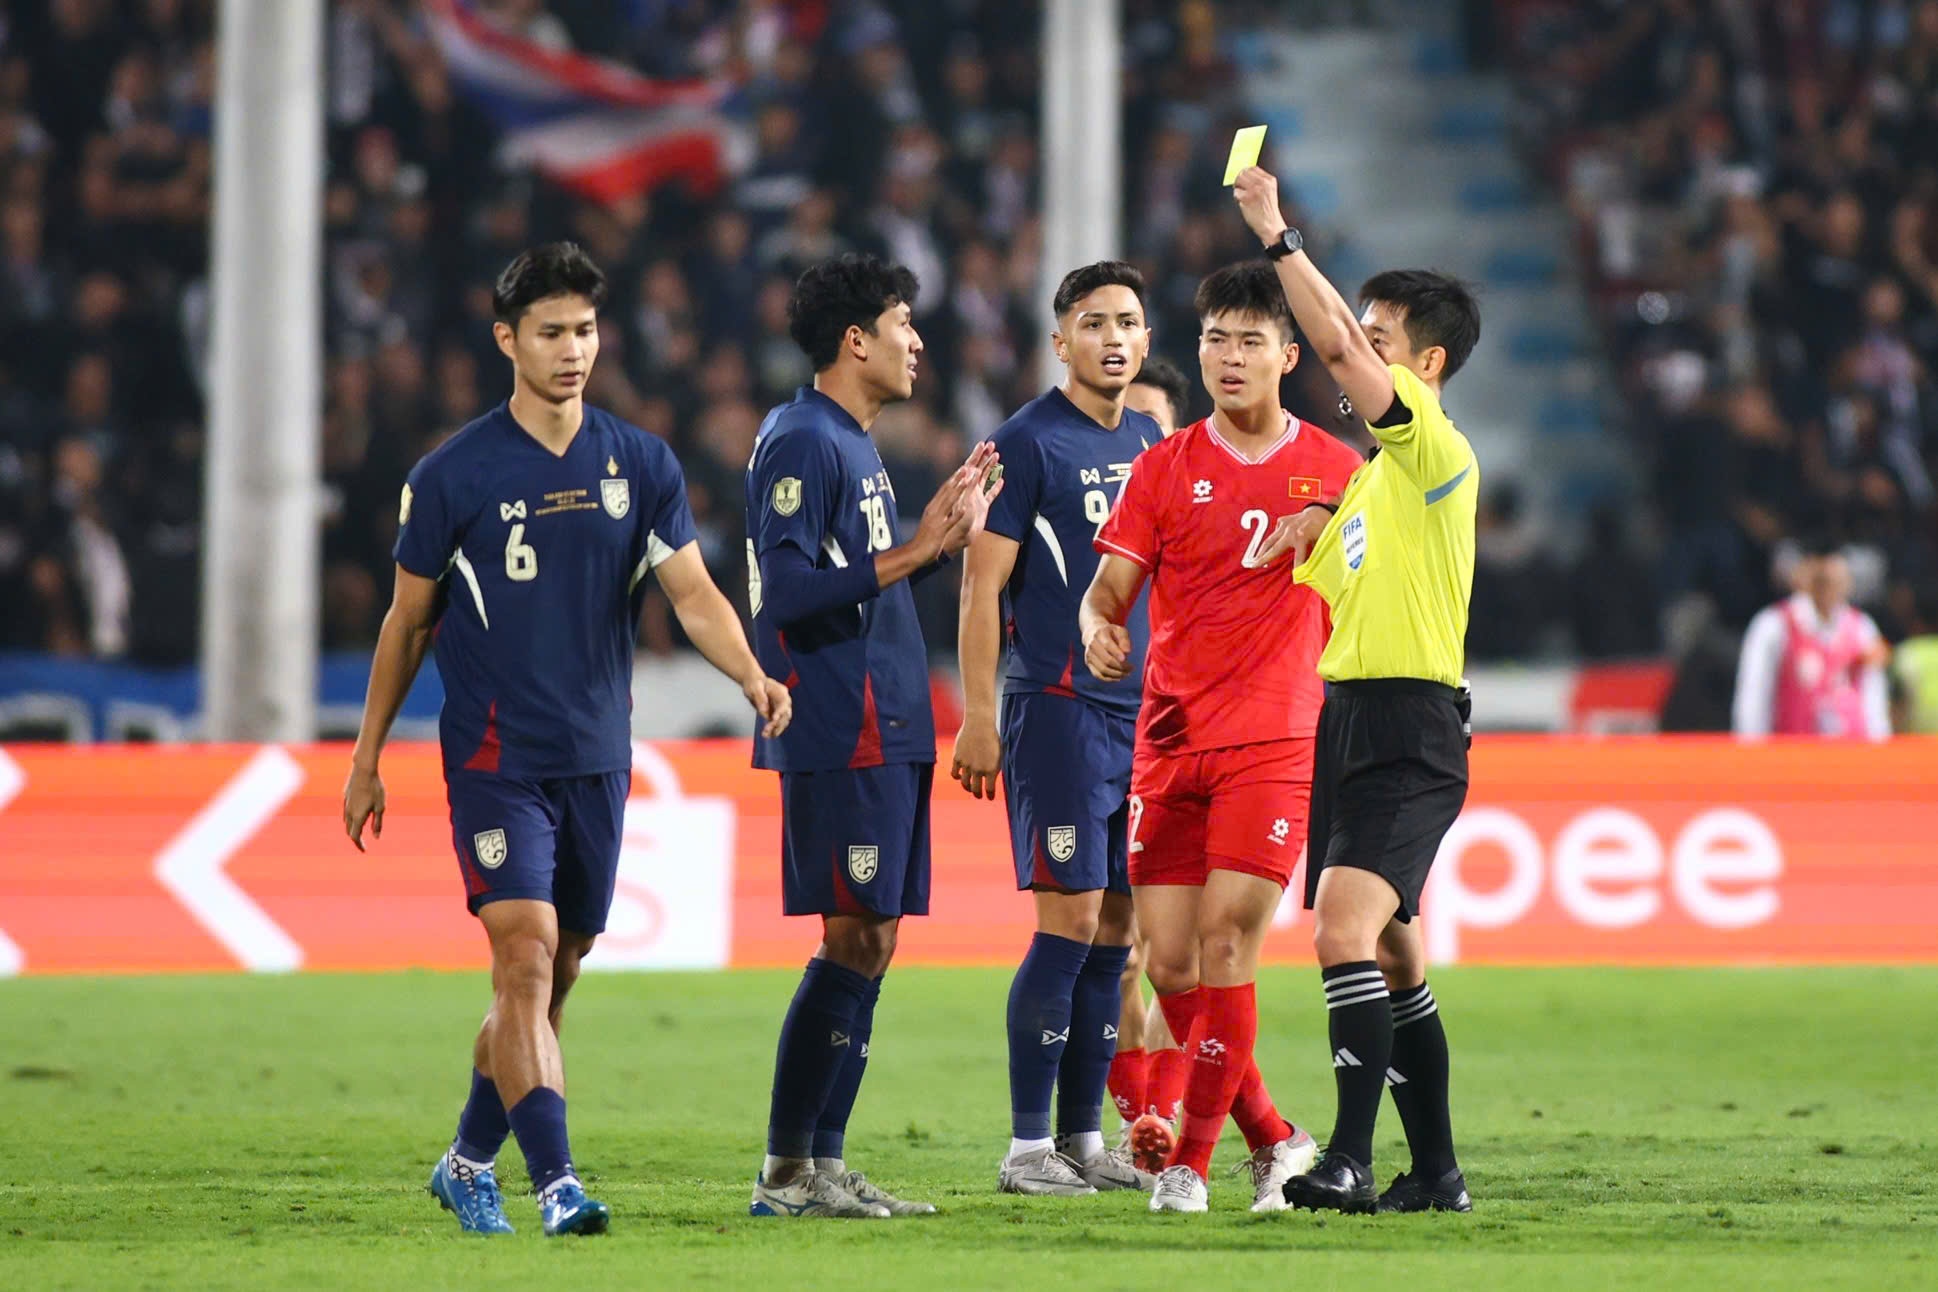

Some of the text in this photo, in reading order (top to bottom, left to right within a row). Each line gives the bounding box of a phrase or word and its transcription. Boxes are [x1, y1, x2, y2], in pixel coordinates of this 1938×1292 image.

[860, 495, 892, 553] 18
[1085, 490, 1110, 539] 9
[1241, 509, 1269, 568] 2
[1342, 516, 1363, 541] FIFA
[505, 523, 538, 581] 6
[1129, 795, 1144, 853] 2
[1434, 807, 1783, 963] pee
